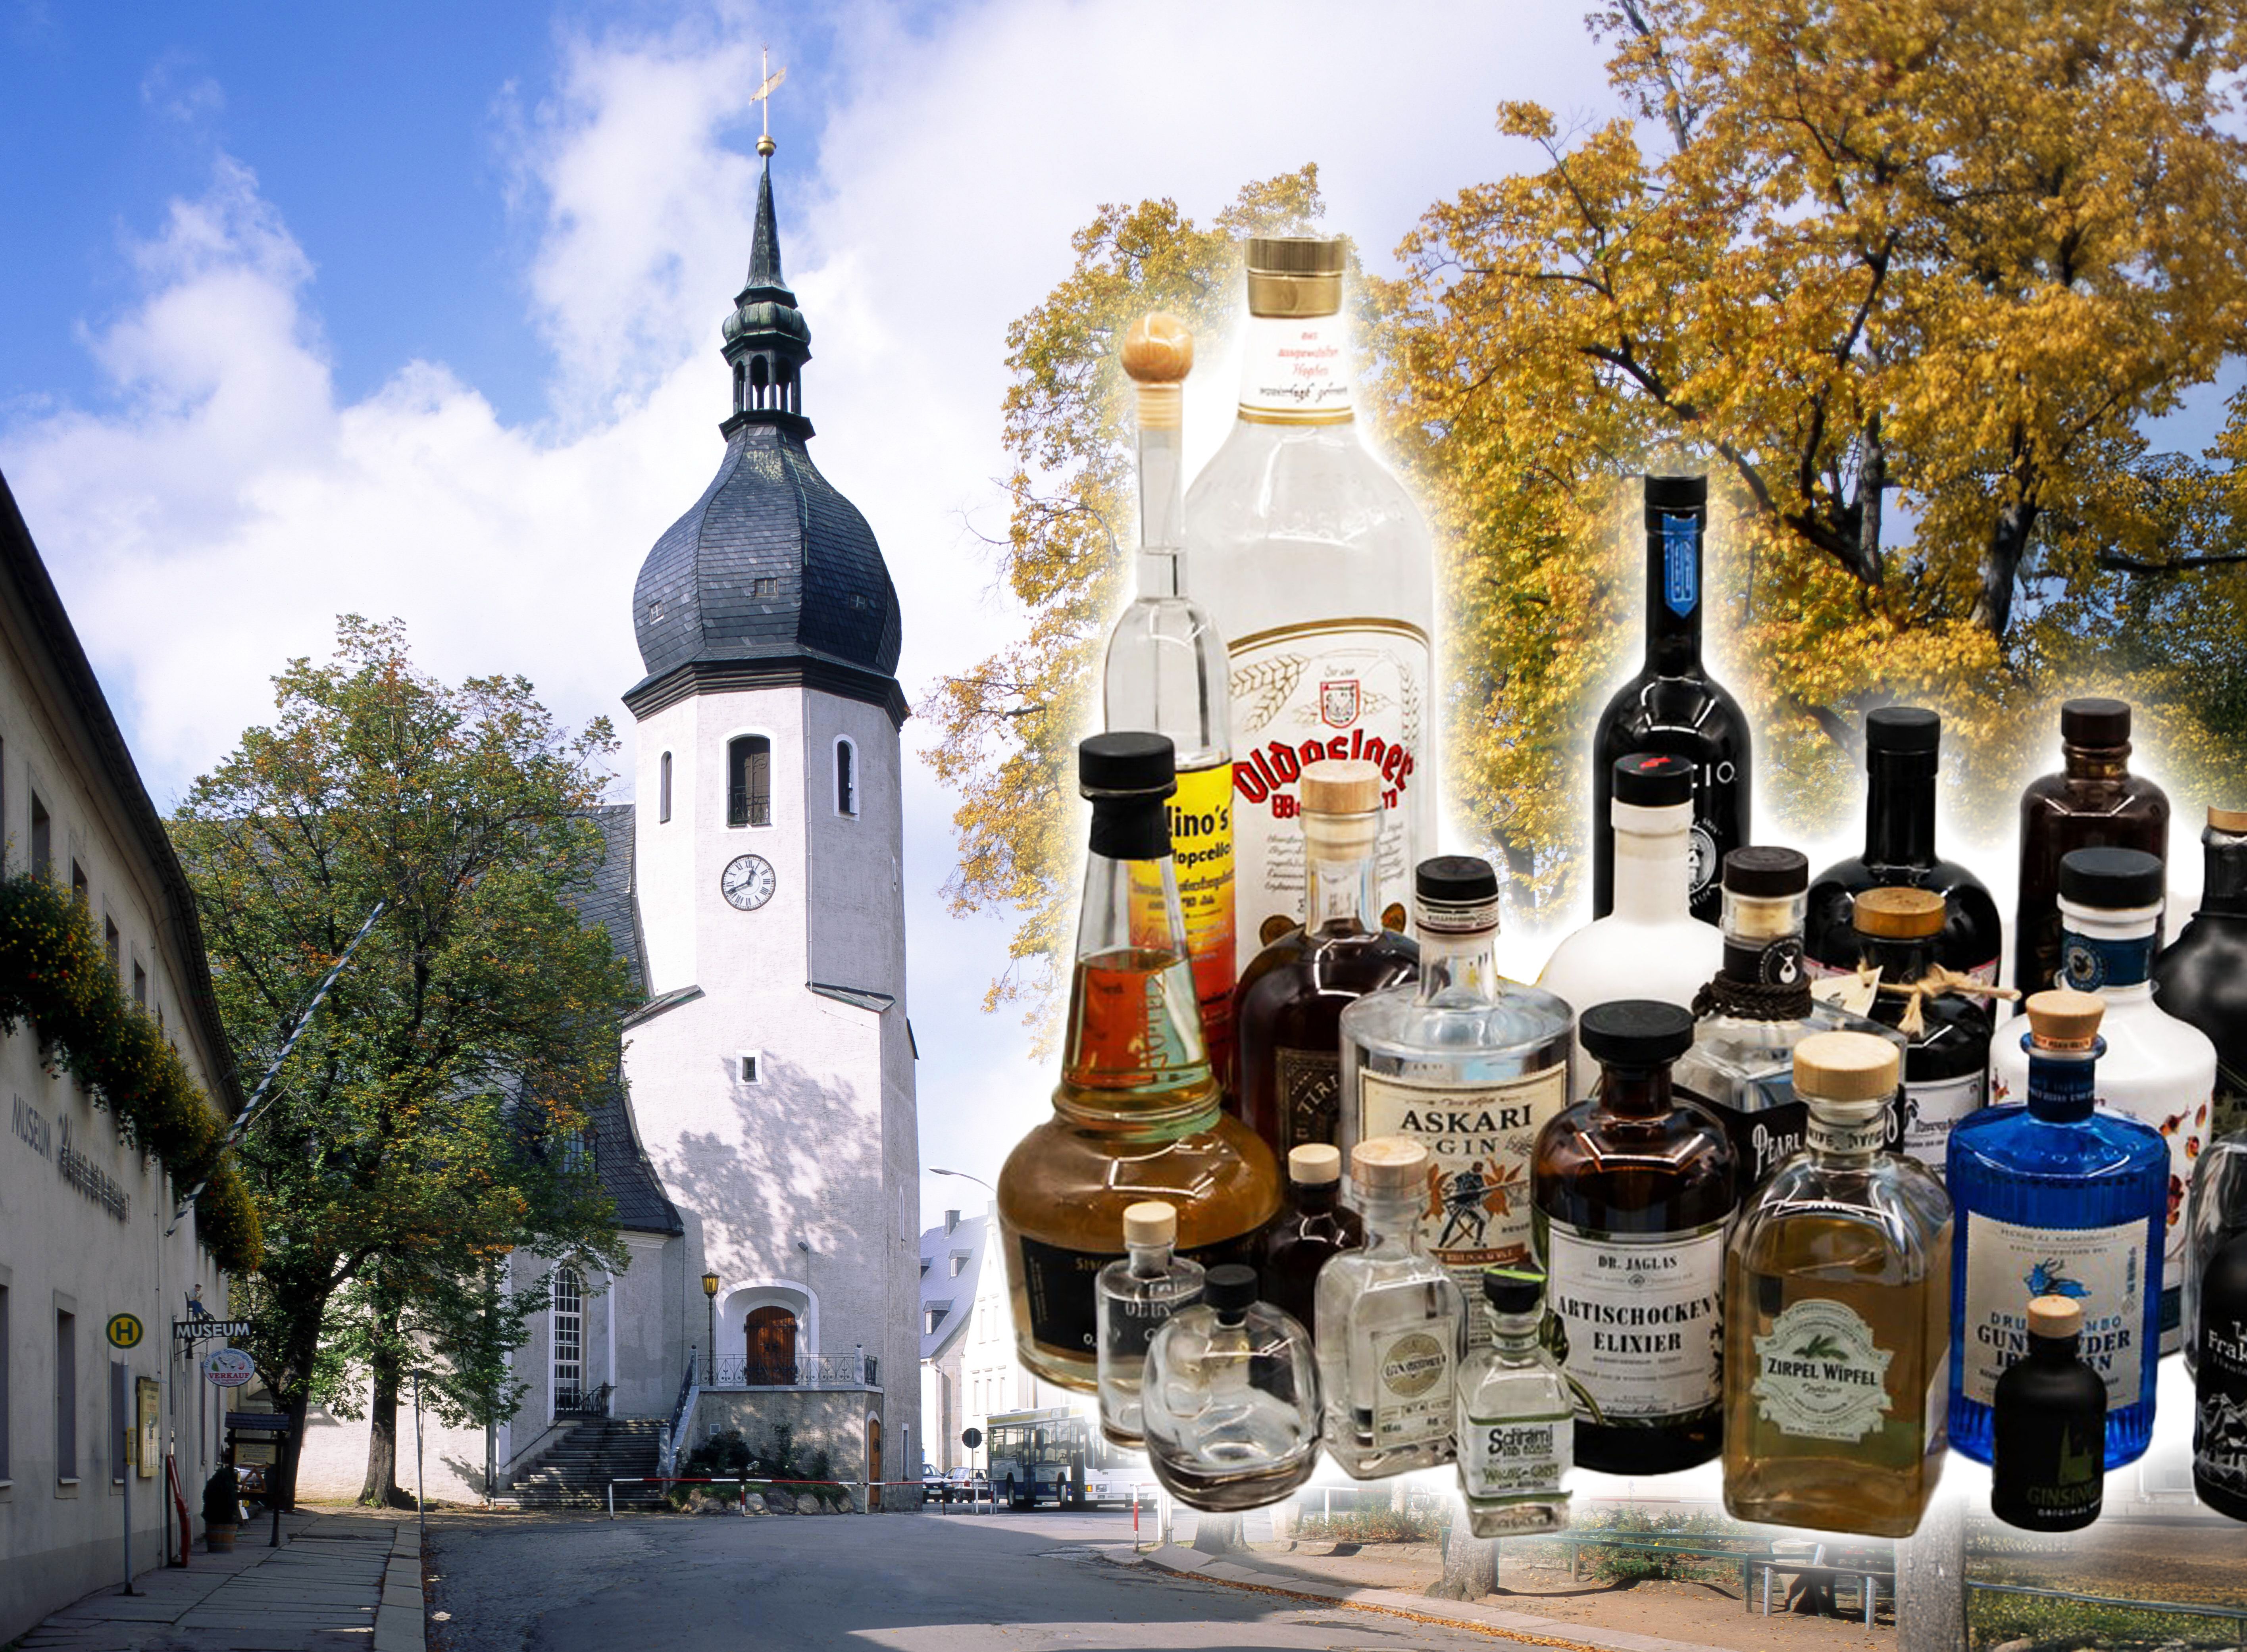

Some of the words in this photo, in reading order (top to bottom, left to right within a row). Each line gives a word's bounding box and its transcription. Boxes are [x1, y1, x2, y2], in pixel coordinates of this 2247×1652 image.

[12, 1092, 52, 1163] MUSEUM
[1401, 1104, 1533, 1133] ASKARI
[1435, 1137, 1500, 1154] GIN
[1752, 1123, 1802, 1181] PEARL
[116, 1322, 133, 1341] H
[176, 1323, 249, 1337] MUSEUM
[1593, 1331, 1681, 1354] ELIXIER
[1768, 1357, 1819, 1379] ZIRPEL
[1823, 1362, 1878, 1386] WIPFEL
